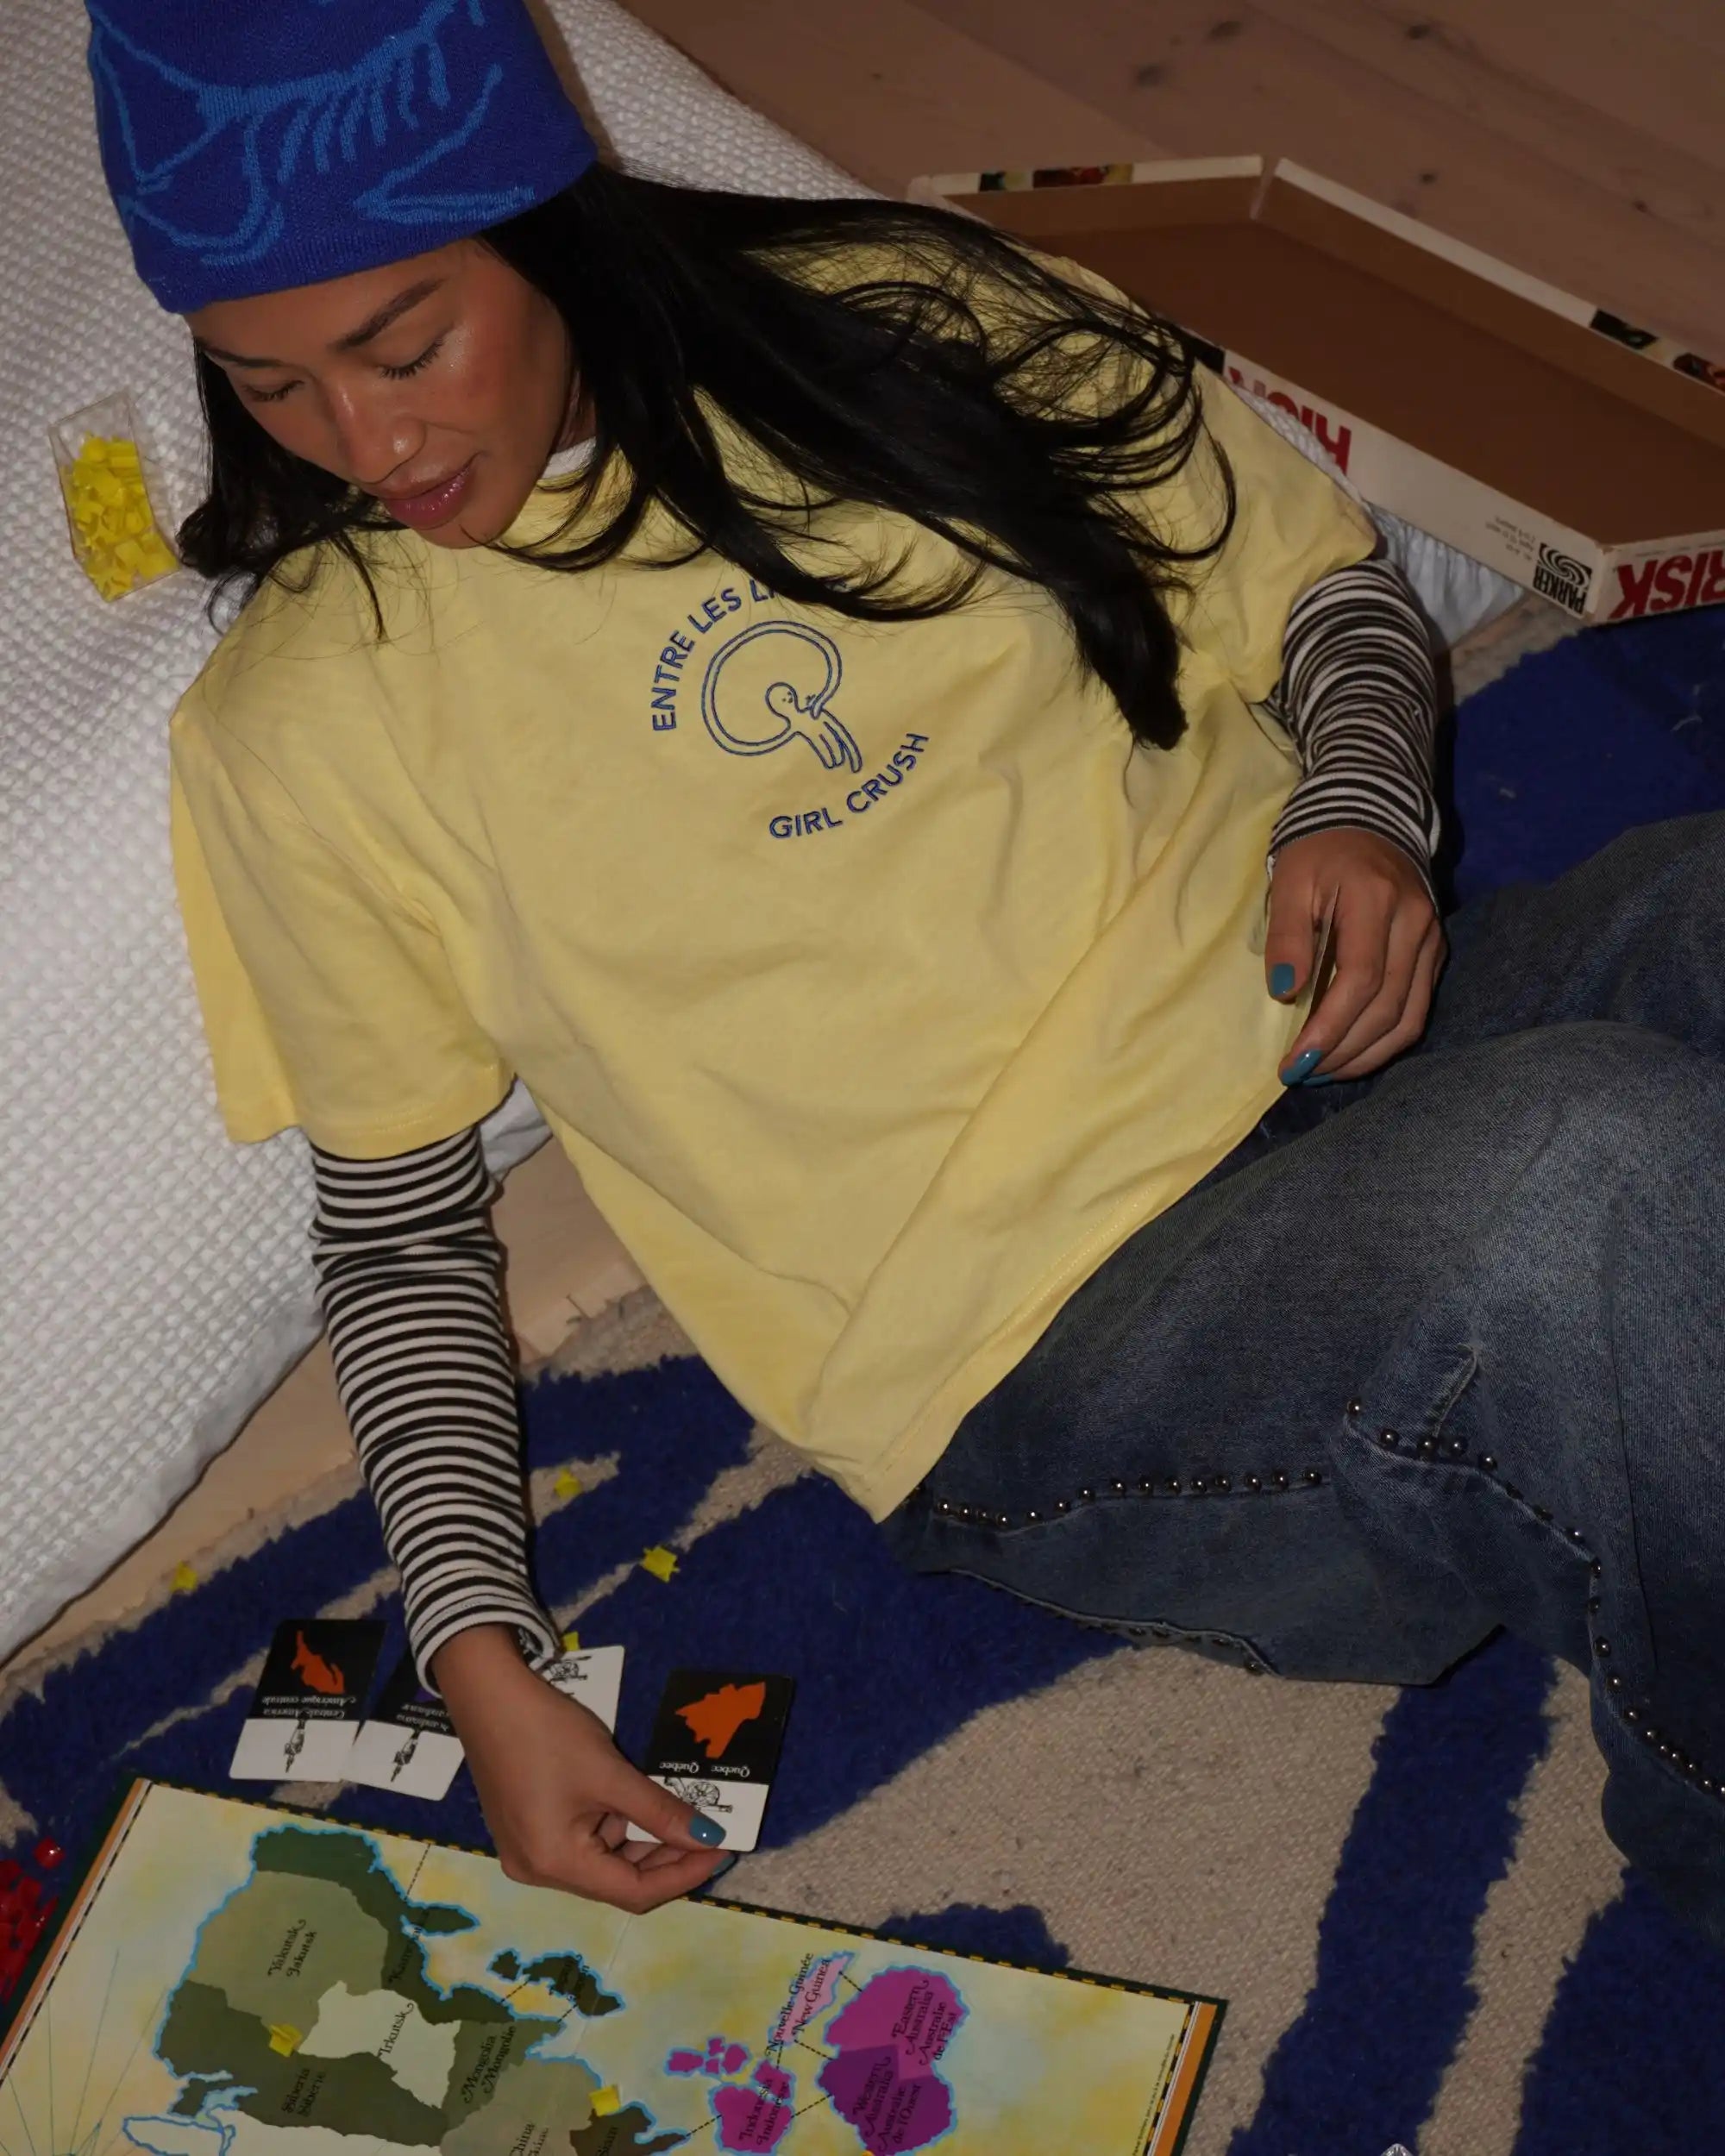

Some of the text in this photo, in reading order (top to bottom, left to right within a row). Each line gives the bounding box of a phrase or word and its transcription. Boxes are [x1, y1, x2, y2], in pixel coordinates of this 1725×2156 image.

[1532, 565, 1585, 615] PARKER
[1608, 549, 1725, 620] RISK
[650, 587, 741, 731] ENTRE LES
[769, 733, 930, 839] GIRL CRUSH
[658, 1761, 750, 1778] Quebec Québec
[794, 1957, 833, 2035] New Guinea
[892, 1979, 929, 2038] Eastern
[906, 1990, 936, 2055] Australia
[379, 2002, 415, 2058] Irkutsk
[482, 2025, 518, 2093] Mongolie
[919, 2001, 948, 2065] Australie
[461, 2034, 498, 2103] Mongolia
[865, 2070, 895, 2136] Australia
